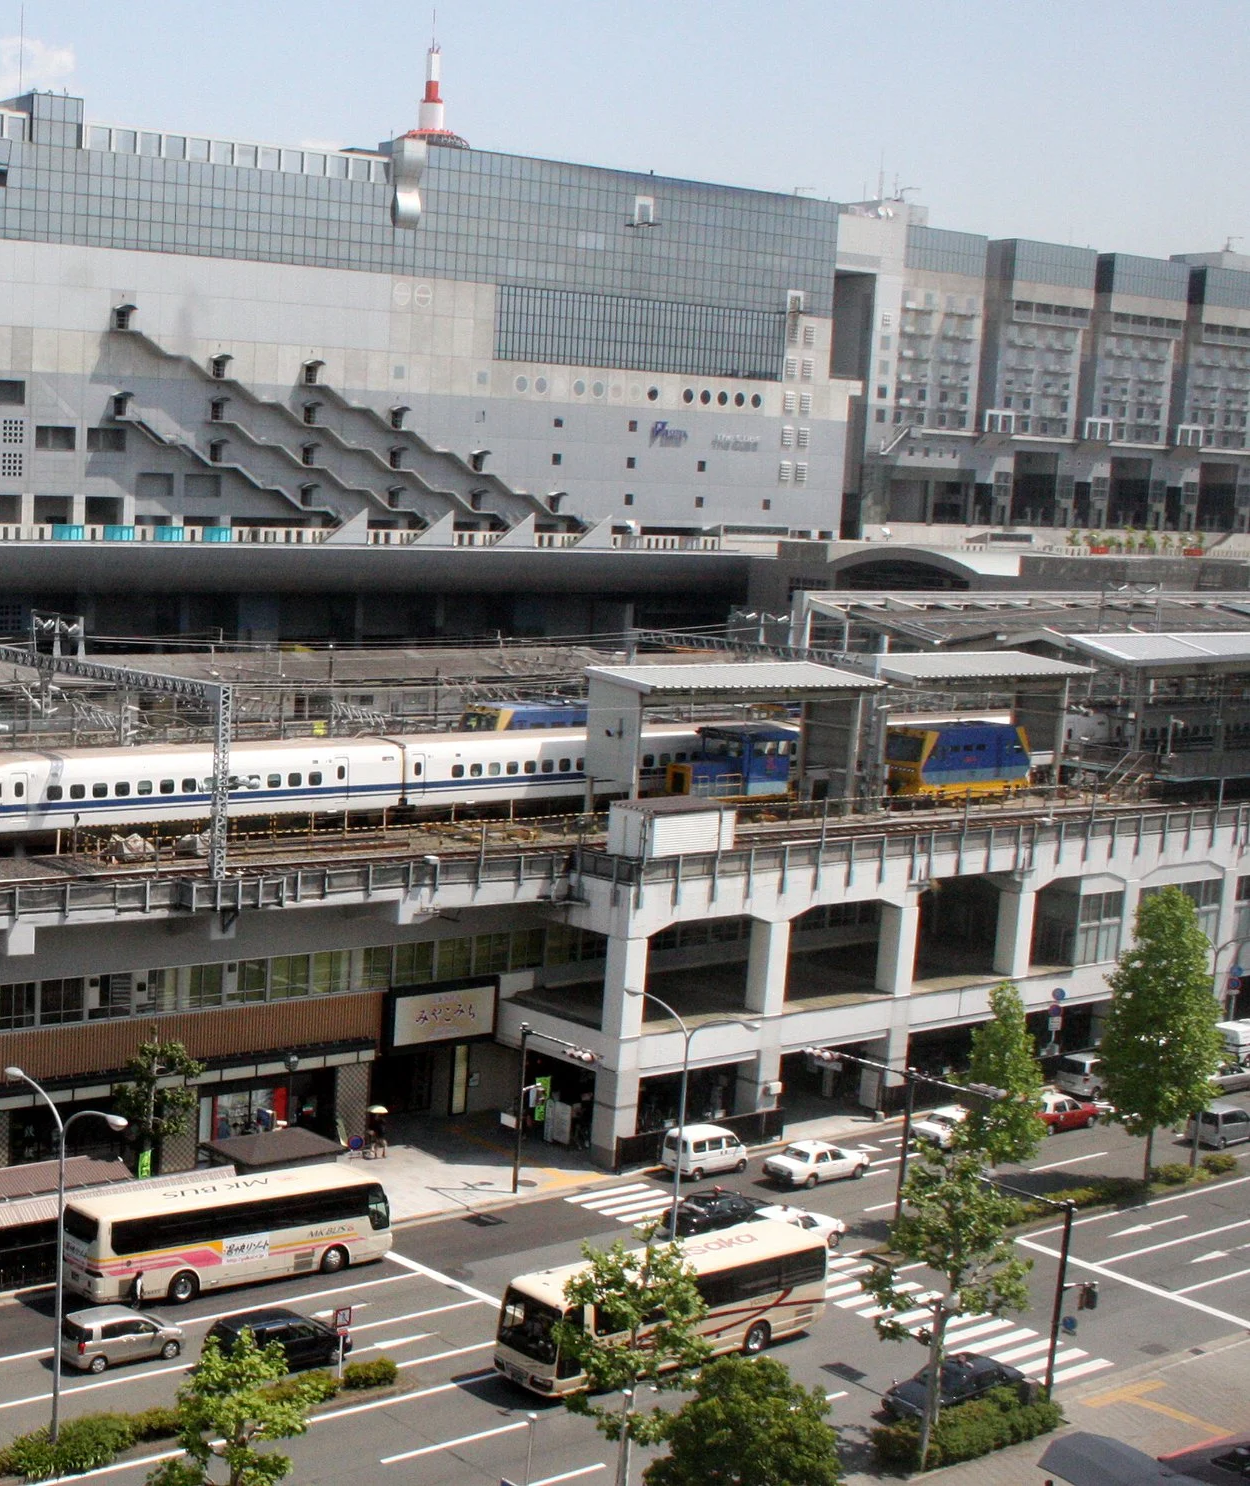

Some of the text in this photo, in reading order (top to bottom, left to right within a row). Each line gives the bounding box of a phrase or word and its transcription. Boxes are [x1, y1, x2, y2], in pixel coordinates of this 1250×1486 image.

[416, 1004, 476, 1025] みやこみち
[162, 1178, 269, 1199] MK BUS
